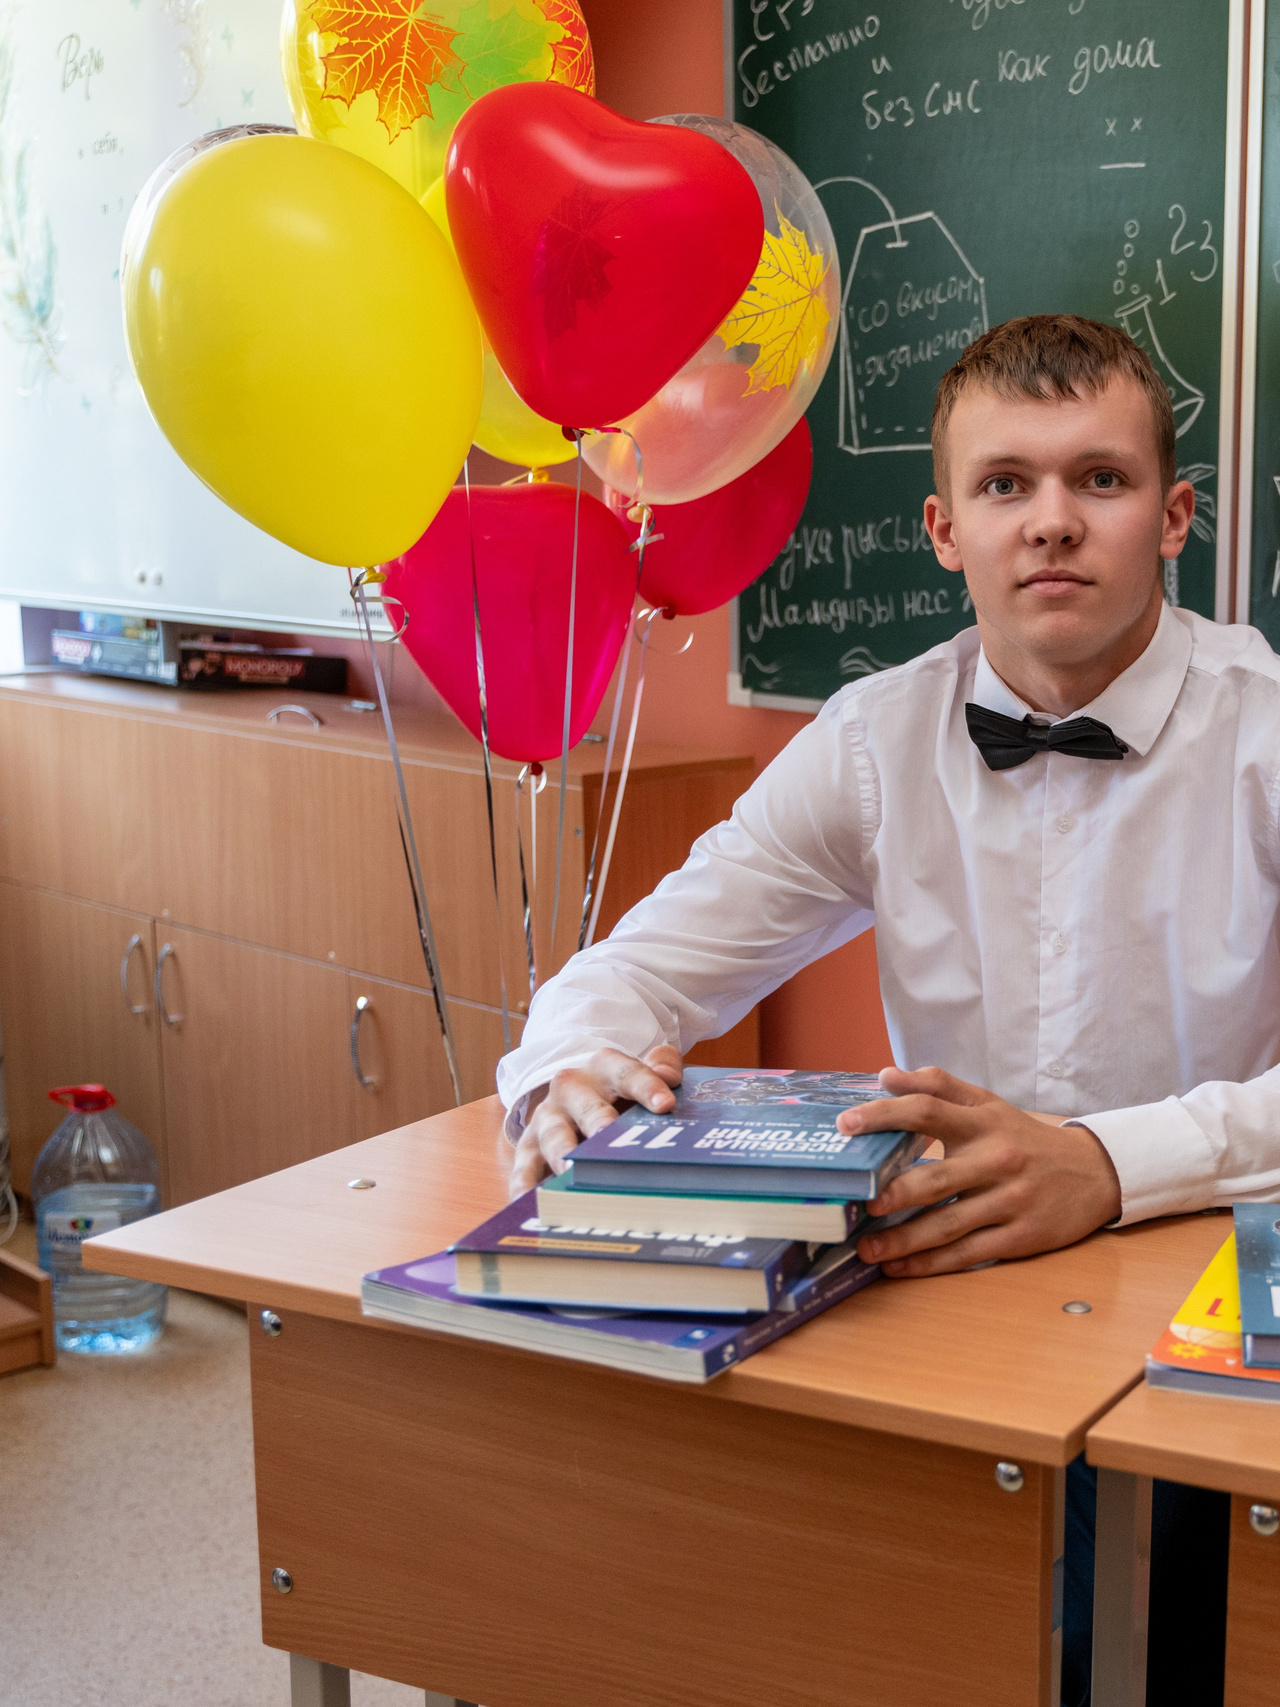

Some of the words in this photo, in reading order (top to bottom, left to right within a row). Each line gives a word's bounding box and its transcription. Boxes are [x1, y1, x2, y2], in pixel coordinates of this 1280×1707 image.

[737, 15, 880, 107] бесплатно
[872, 56, 892, 75] и
[1068, 37, 1161, 95] дома
[862, 89, 915, 130] без
[858, 299, 889, 333] со
[897, 276, 973, 320] вкусом
[747, 584, 896, 643] Мальдивы
[903, 588, 950, 622] нас
[226, 658, 304, 677] MONOPOLY
[607, 1124, 684, 1149] 11
[693, 1139, 846, 1154] ВСЕОБЩАЯ
[702, 1128, 852, 1144] ИСТОРИЯ
